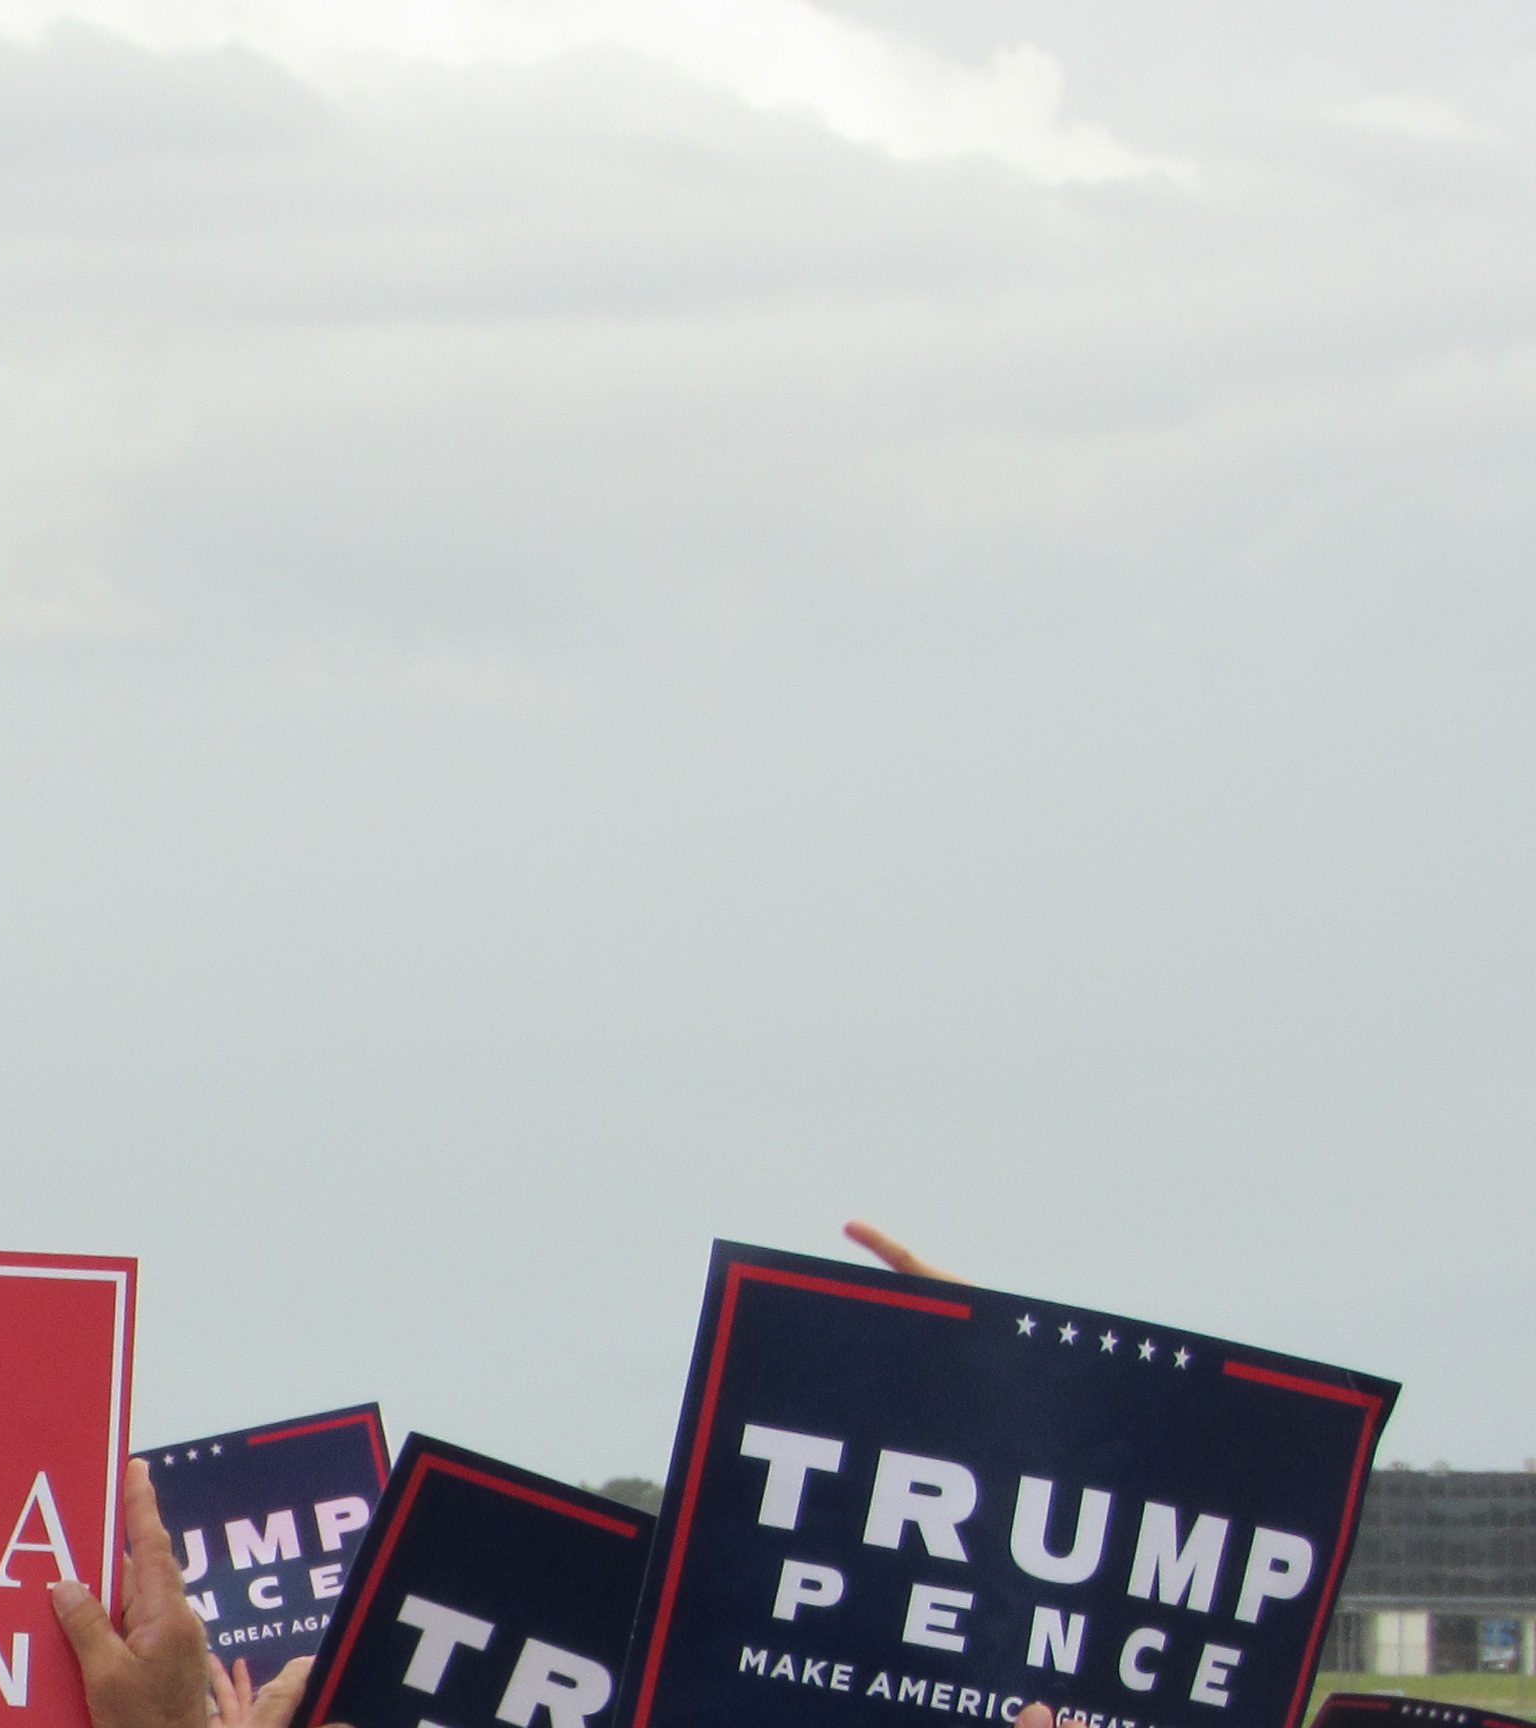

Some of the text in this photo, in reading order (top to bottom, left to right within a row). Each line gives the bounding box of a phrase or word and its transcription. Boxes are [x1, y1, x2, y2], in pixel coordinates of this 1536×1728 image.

[738, 1423, 1314, 1625] TRUMP
[218, 1622, 283, 1646] GREAT
[738, 1646, 854, 1692] MAKE
[867, 1671, 1024, 1723] AMERIC
[771, 1559, 1243, 1708] PENCE
